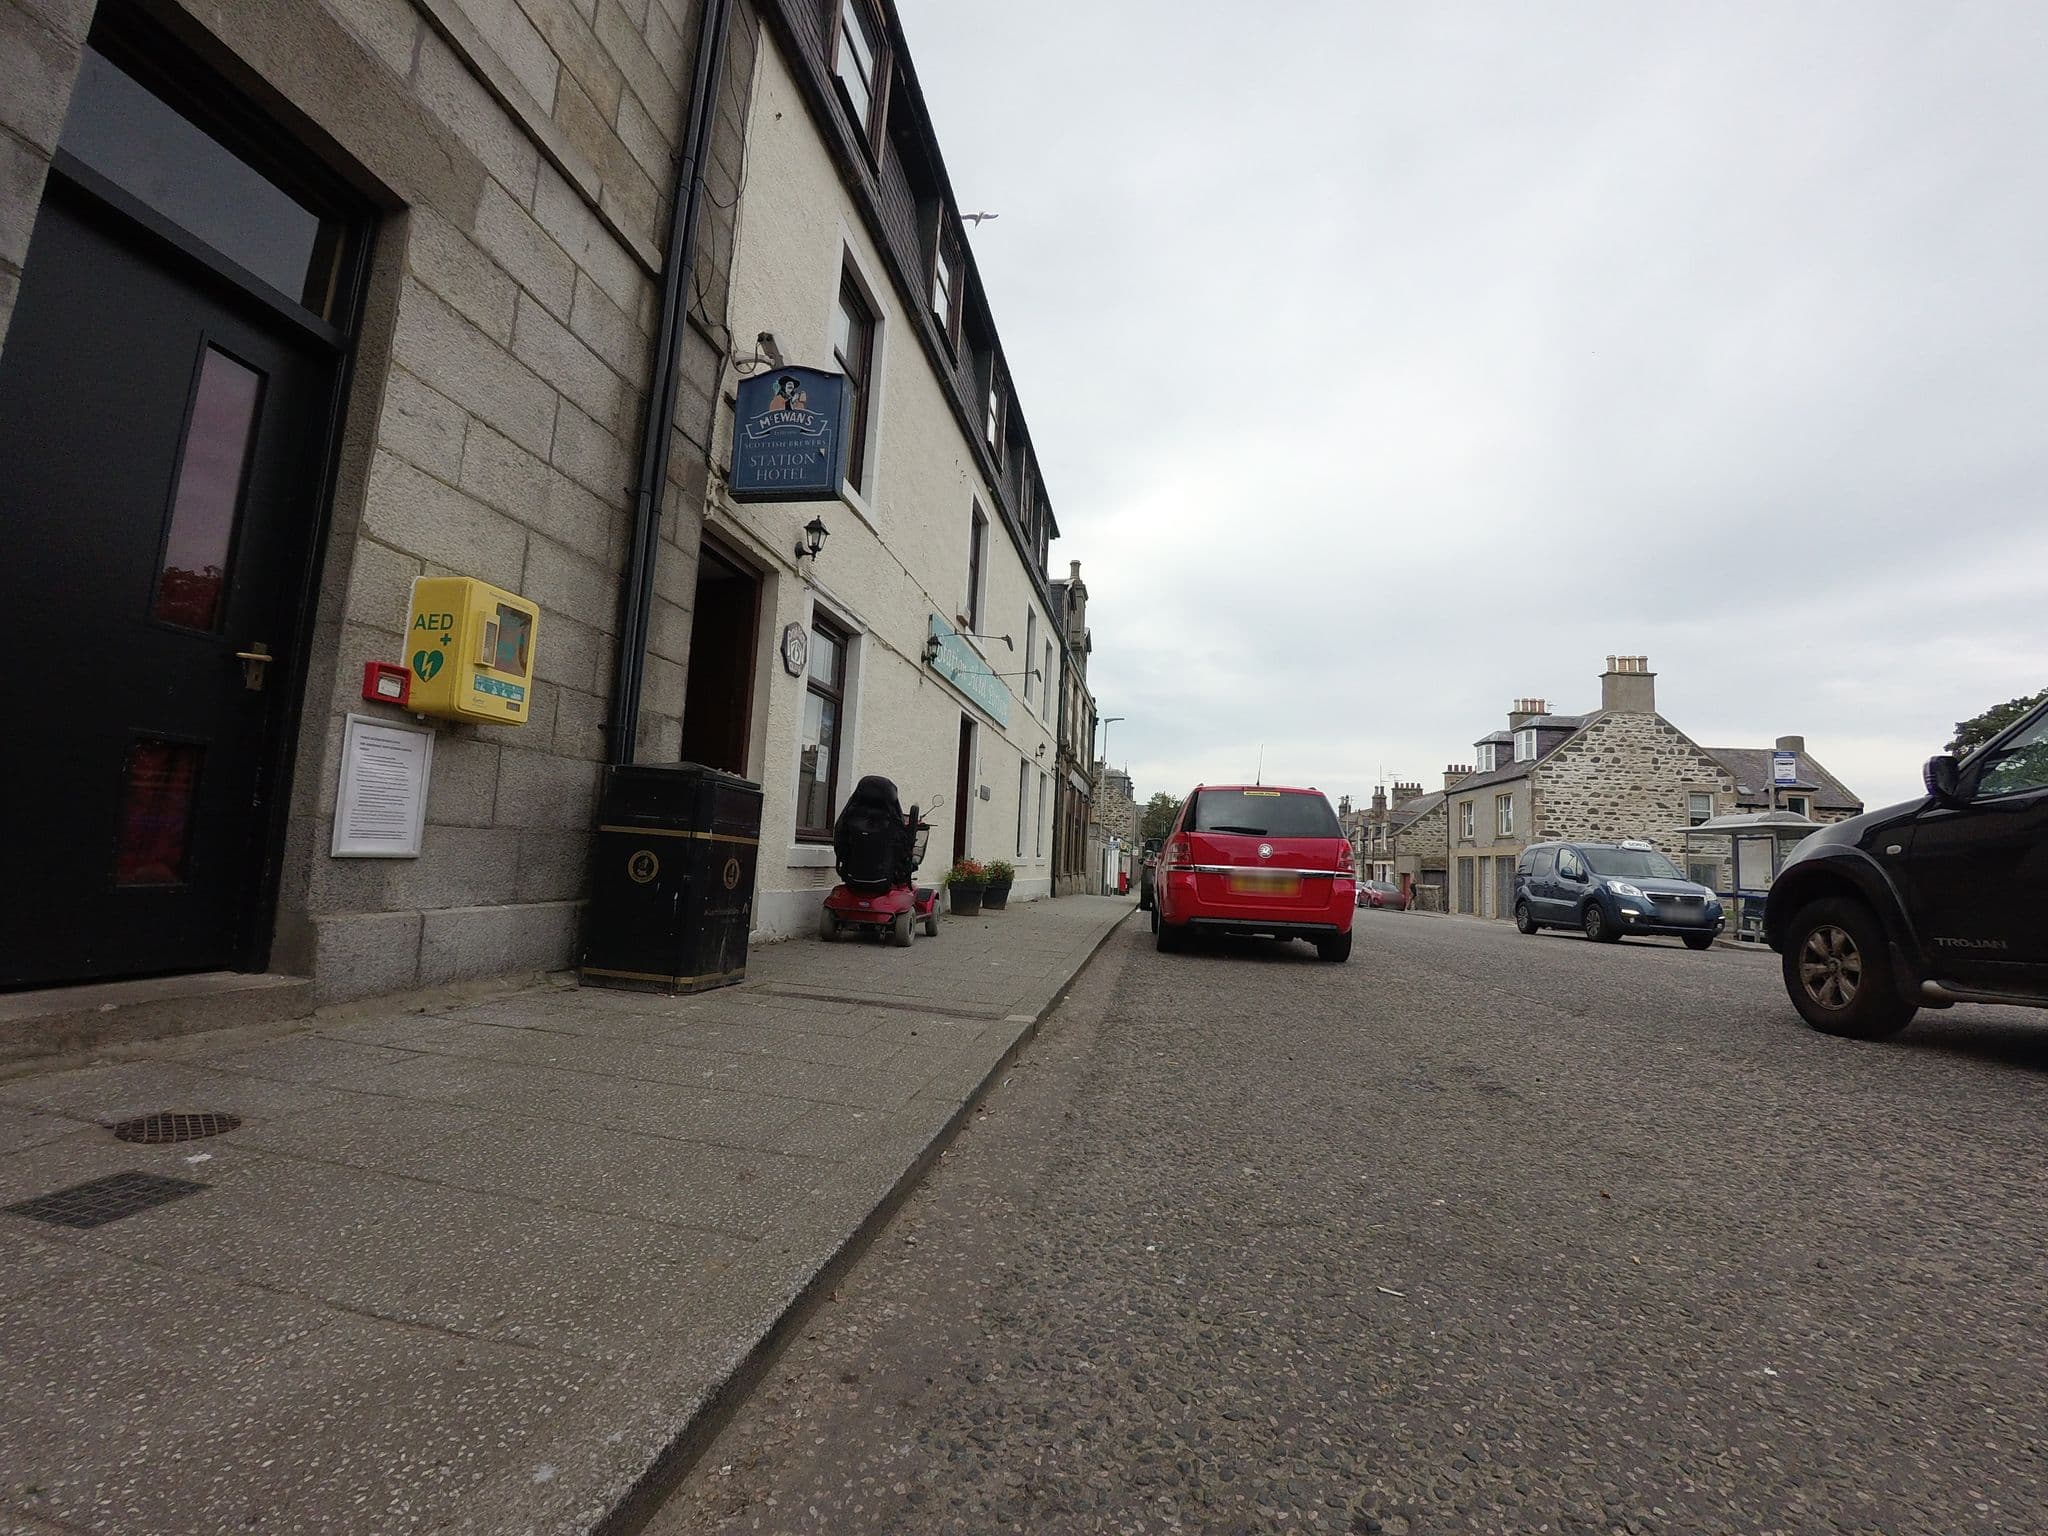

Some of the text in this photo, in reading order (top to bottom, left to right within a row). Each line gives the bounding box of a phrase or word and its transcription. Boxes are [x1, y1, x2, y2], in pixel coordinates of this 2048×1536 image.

[750, 453, 815, 466] STATION
[757, 468, 807, 480] HOTEL
[413, 613, 454, 631] AED
[1933, 937, 2008, 949] TROJAN
